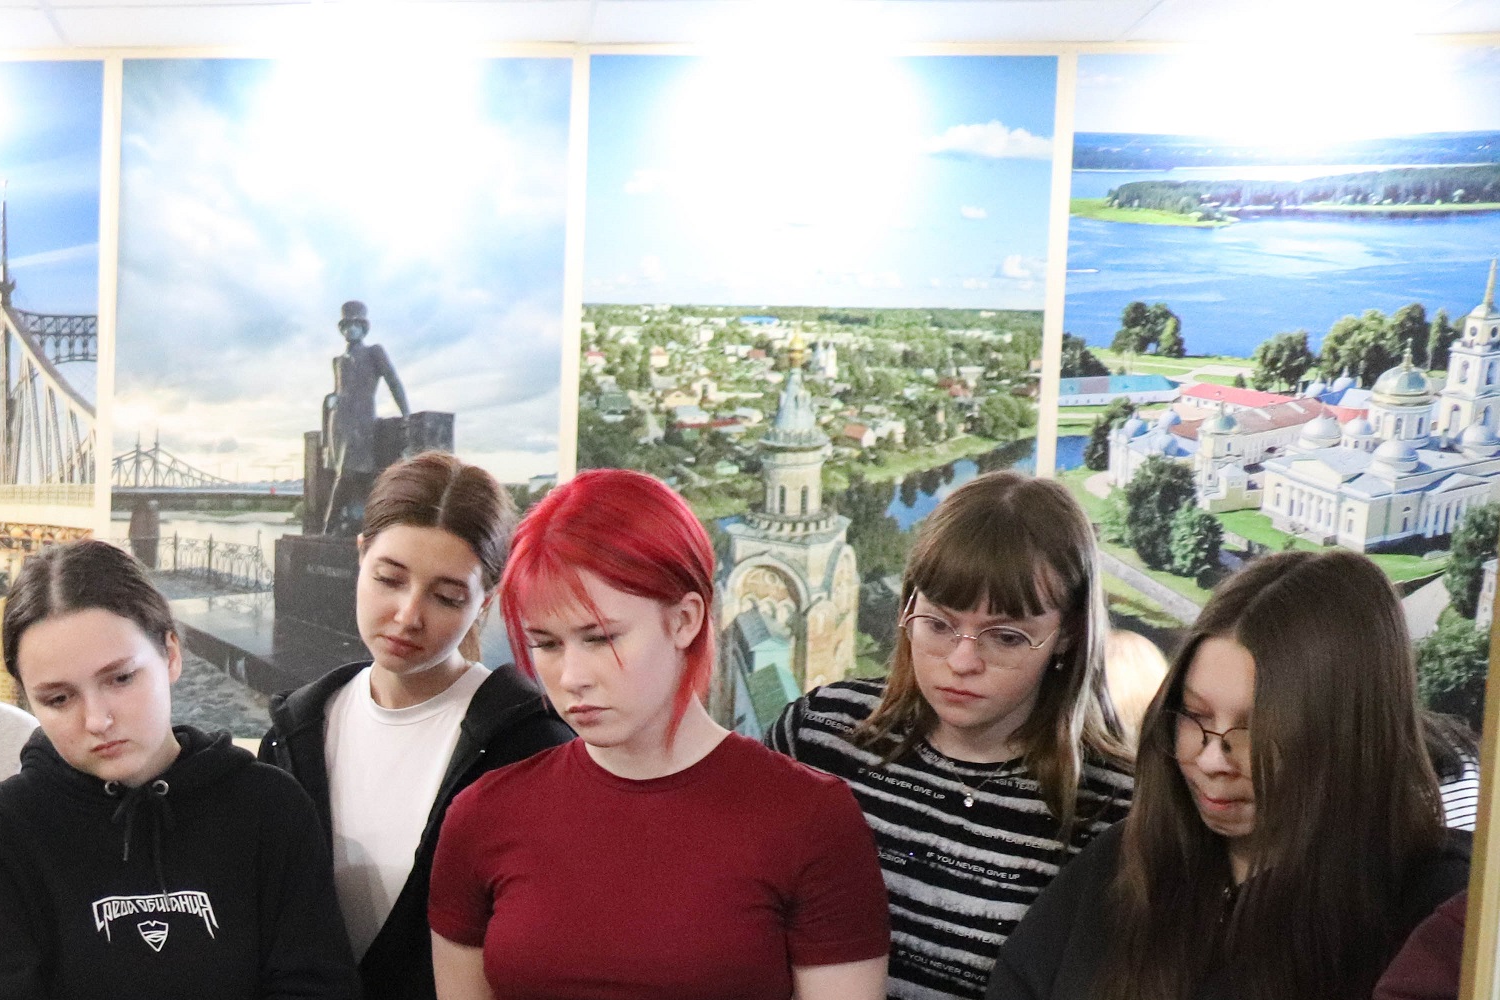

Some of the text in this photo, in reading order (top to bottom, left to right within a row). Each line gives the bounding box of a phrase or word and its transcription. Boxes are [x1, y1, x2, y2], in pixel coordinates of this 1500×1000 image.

[868, 771, 885, 782] YOU
[885, 776, 913, 790] NEVER
[913, 785, 932, 797] GIVE
[933, 791, 946, 801] UP
[926, 851, 1021, 881] IF YOU NEVER GIVE UP
[909, 954, 928, 964] YOU
[929, 960, 962, 975] NEVER
[963, 971, 987, 983] GIVE
